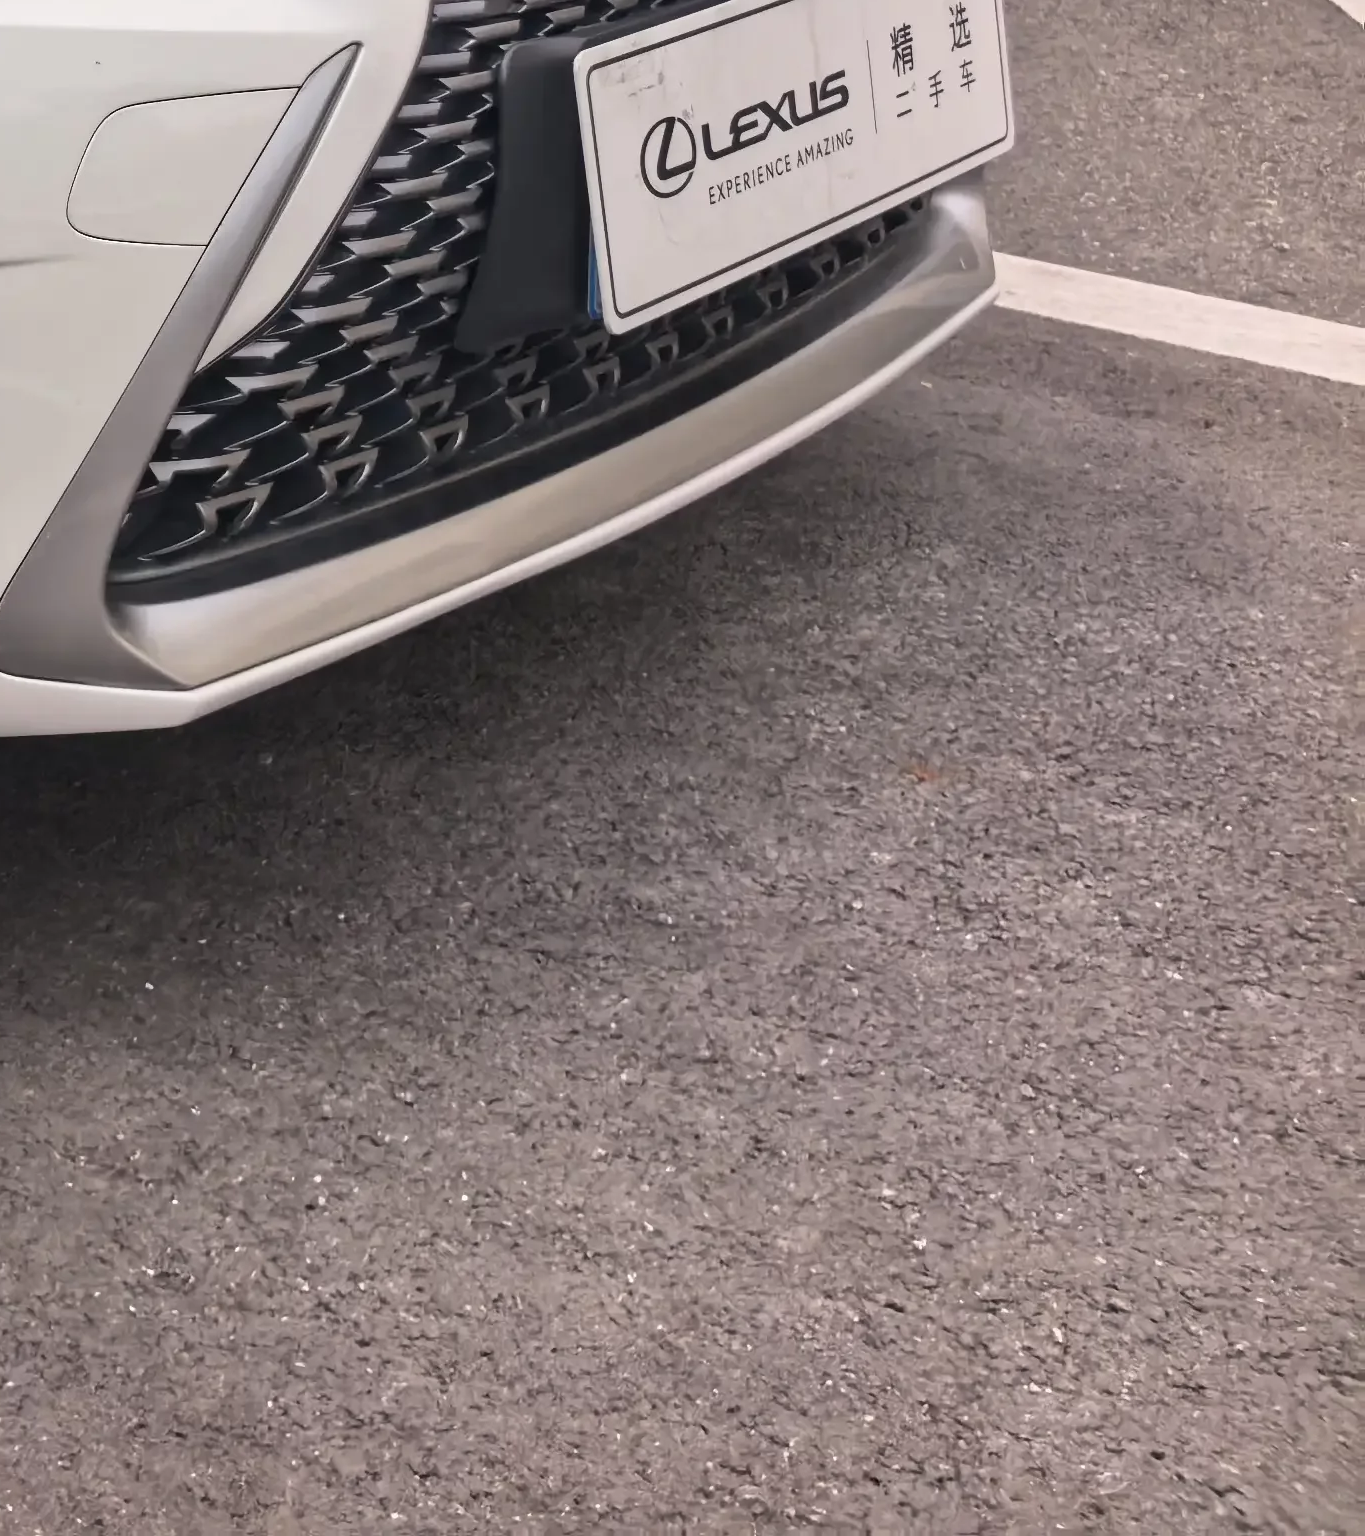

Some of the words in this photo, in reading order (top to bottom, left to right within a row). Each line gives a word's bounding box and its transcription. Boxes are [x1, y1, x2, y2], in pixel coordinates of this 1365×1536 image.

[889, 1, 972, 77] 精选
[700, 70, 851, 161] LEXUS
[895, 59, 977, 118] 二手车
[708, 153, 793, 205] EXPERIENCE
[796, 128, 855, 169] AMAZING
